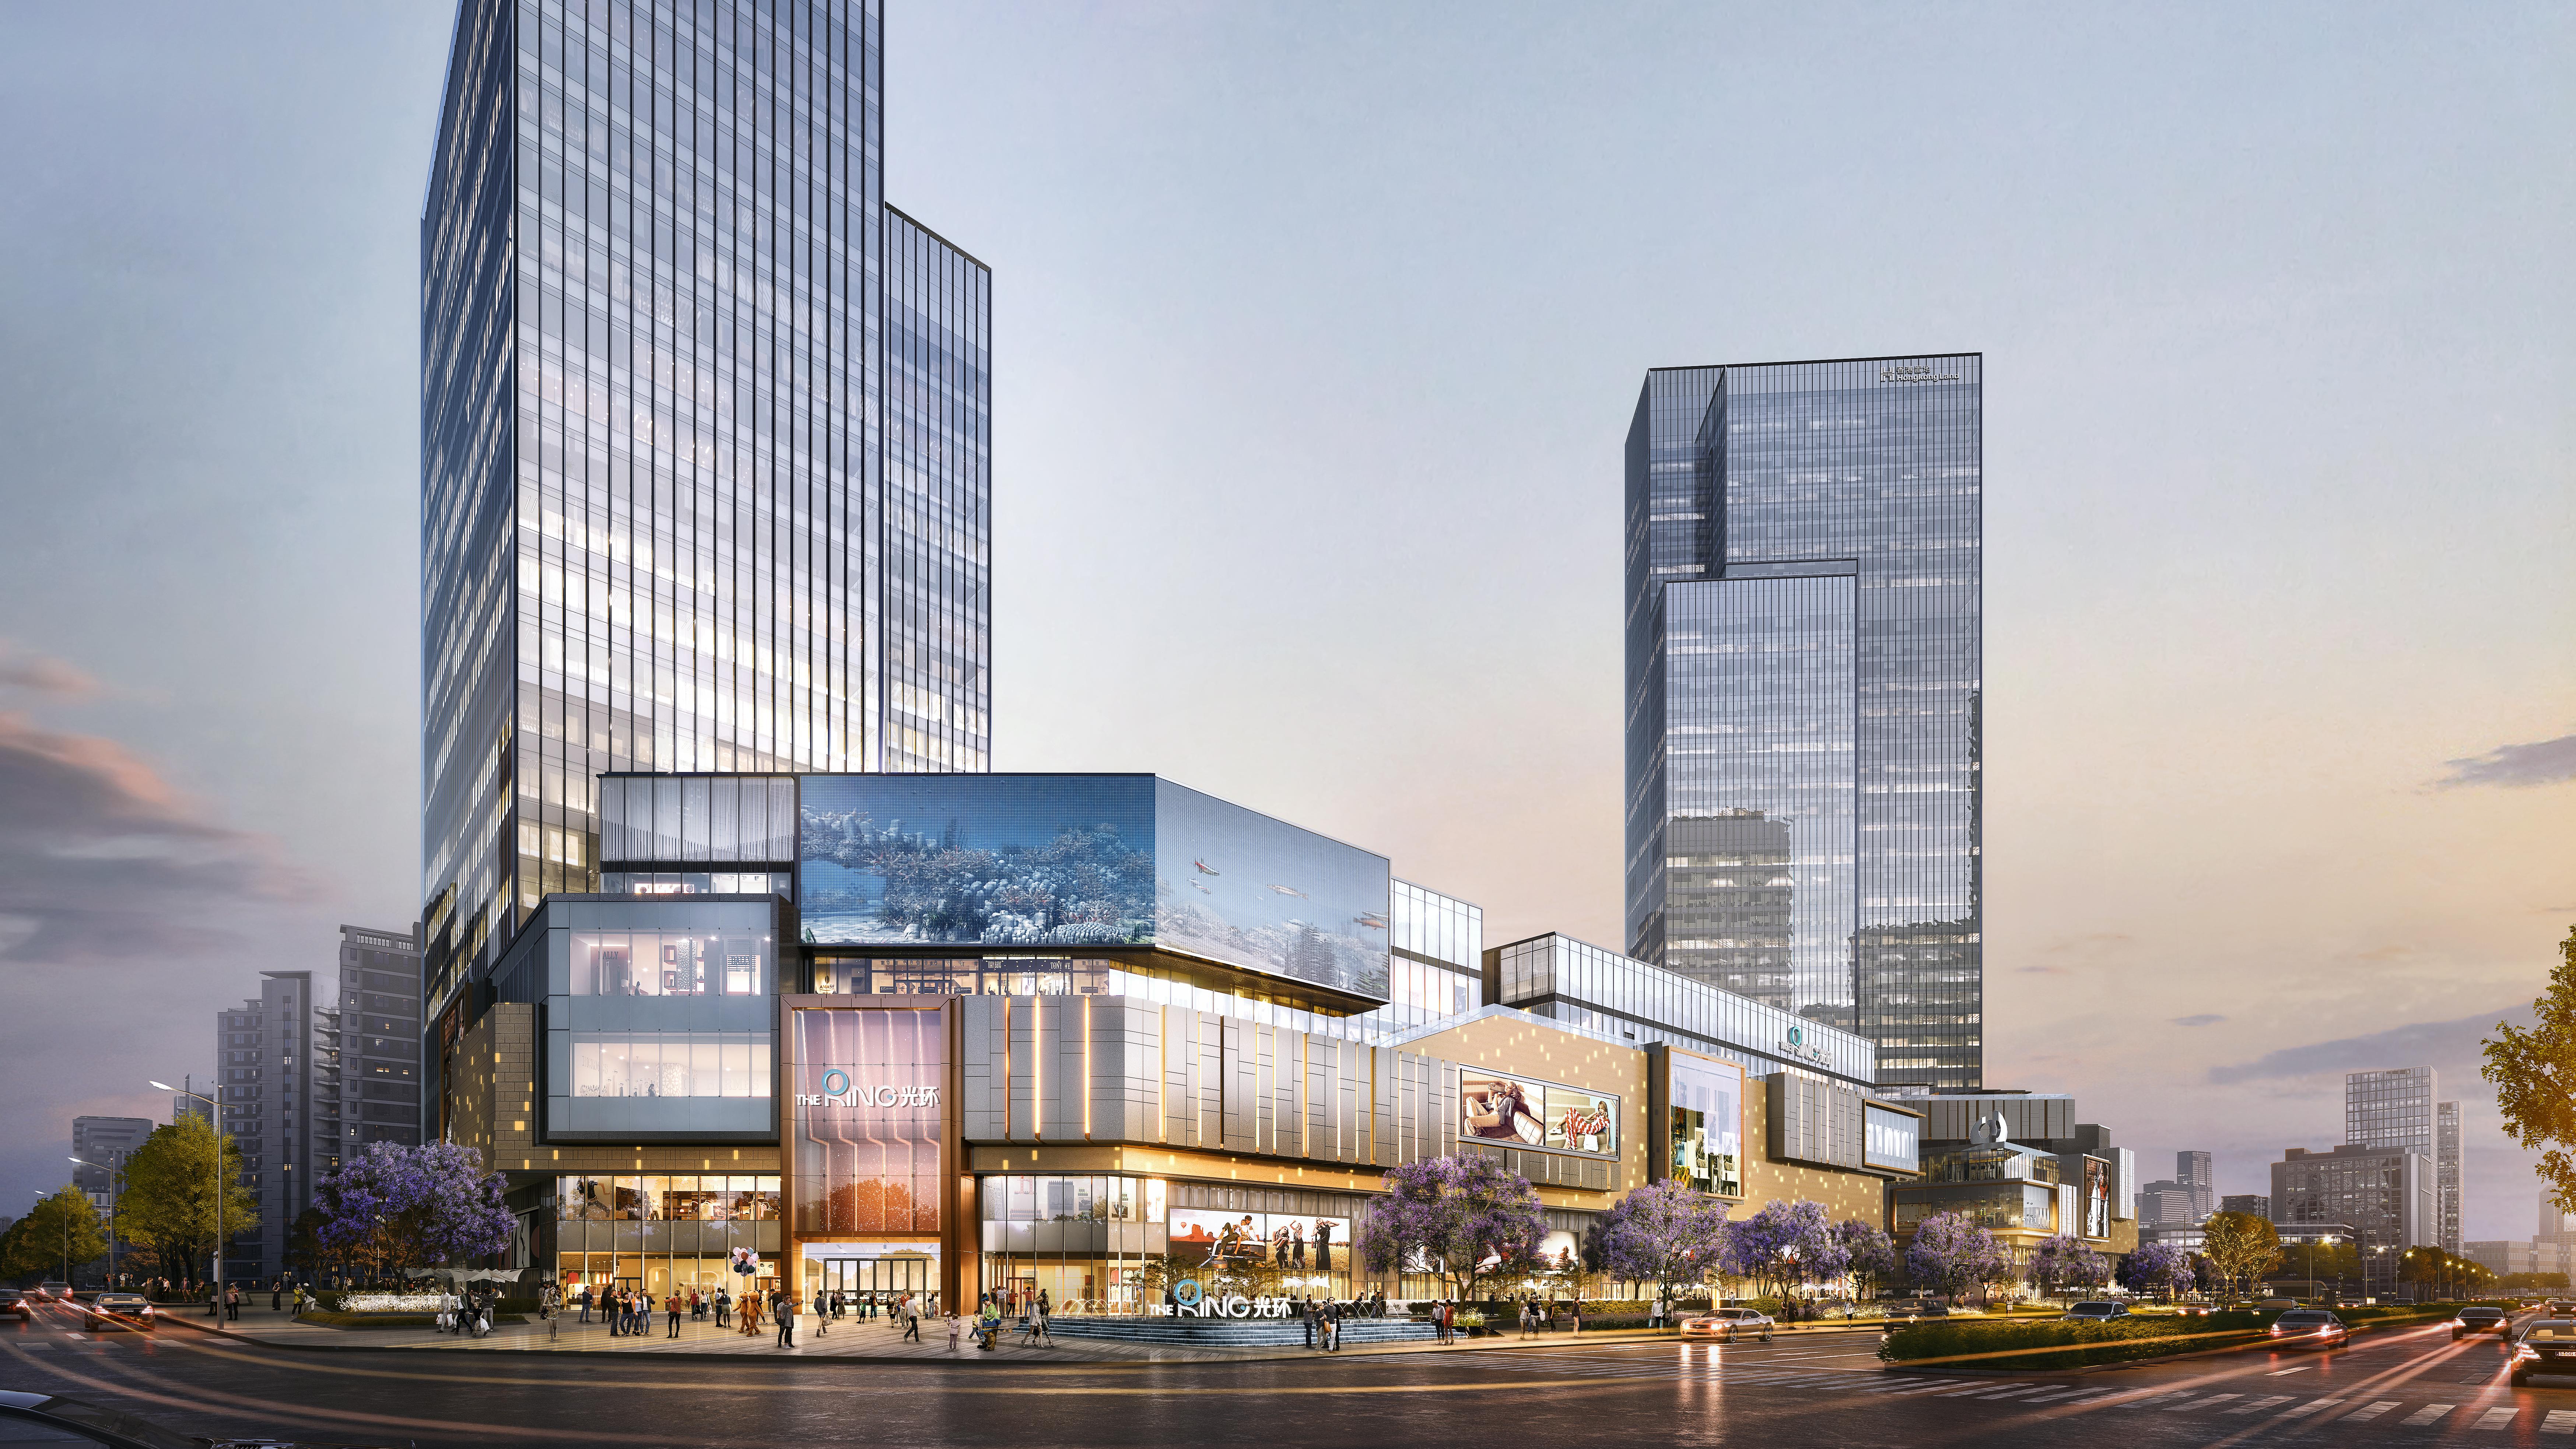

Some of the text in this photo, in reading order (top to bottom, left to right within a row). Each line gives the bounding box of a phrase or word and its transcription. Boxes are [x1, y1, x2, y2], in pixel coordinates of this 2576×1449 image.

[1897, 365, 1930, 374] 香港置地
[1897, 373, 1938, 382] Hongkong
[598, 951, 618, 959] ALLY
[796, 1069, 939, 1107] THE RING 光环
[1149, 1279, 1292, 1318] THE RING 光环
